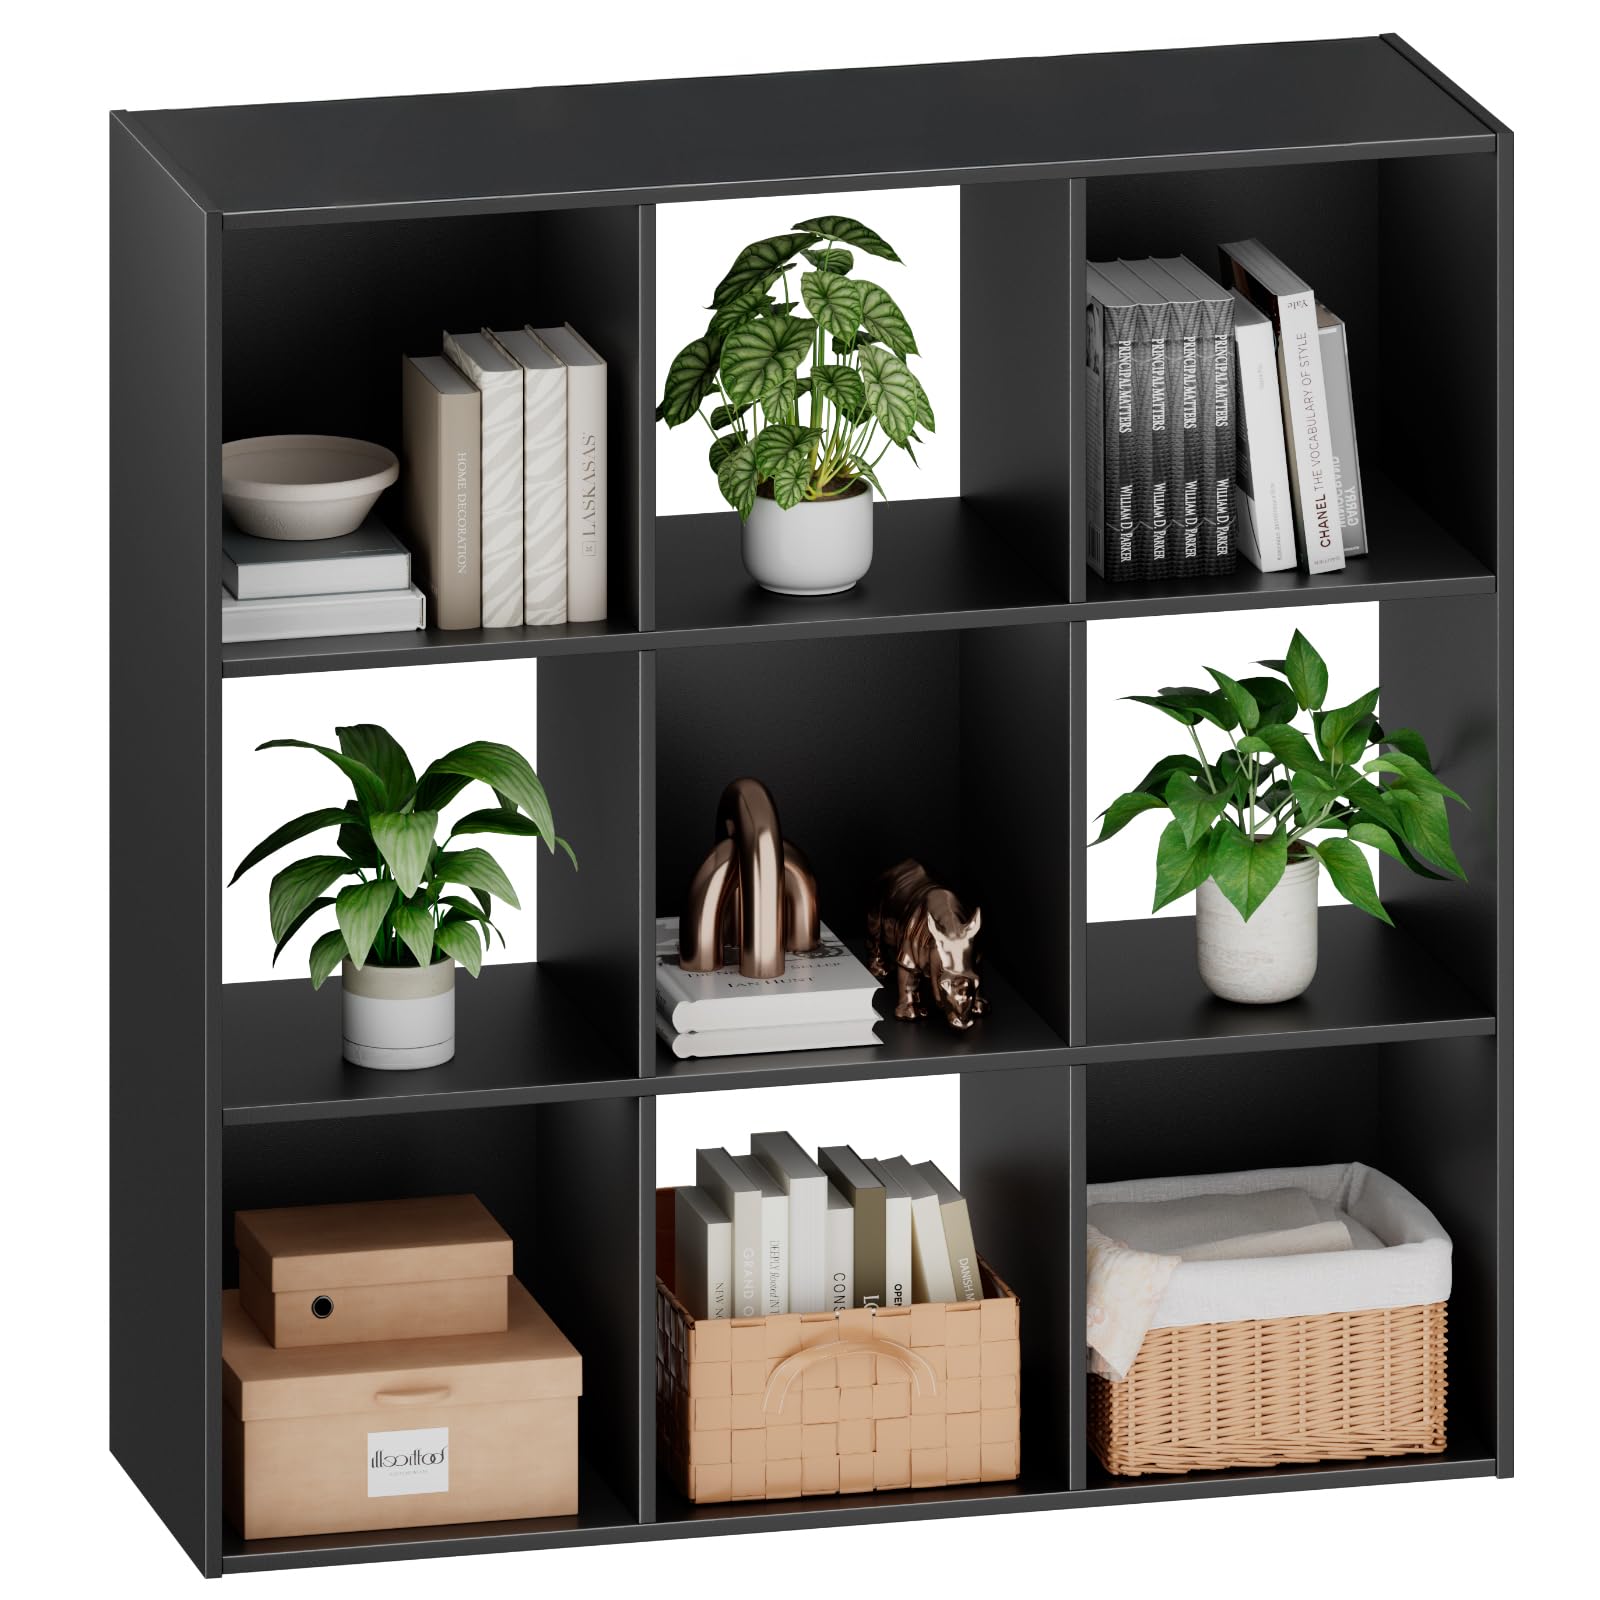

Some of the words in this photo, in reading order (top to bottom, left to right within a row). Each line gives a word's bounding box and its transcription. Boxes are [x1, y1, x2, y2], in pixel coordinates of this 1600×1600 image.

[1287, 299, 1308, 310] Yale
[1118, 340, 1132, 390] PRINCIPAL
[1151, 338, 1165, 387] PRINCIPAL
[1183, 336, 1196, 386] PRINCIPAL
[1215, 334, 1228, 383] PRINCIPAL
[1296, 332, 1310, 368] STYLE
[1301, 371, 1312, 385] OF
[1119, 390, 1132, 433] MATTERS
[1152, 387, 1165, 431] MATTERS
[1183, 386, 1197, 429] MATTERS
[1215, 383, 1229, 427] MATTERS
[1303, 390, 1321, 467] VOCABULARY
[457, 450, 467, 489] HOME
[582, 431, 596, 536] LASKASAS
[1311, 469, 1324, 492] THE
[1120, 484, 1133, 521] WILLIAM
[1153, 482, 1167, 519] WILLIAM
[1184, 480, 1198, 516] WILLIAM
[1216, 478, 1230, 515] WILLIAM
[456, 493, 467, 575] DECORATION
[1120, 521, 1133, 532] D.
[1153, 519, 1166, 529] D.
[1184, 517, 1198, 527] D.
[1216, 515, 1230, 525] D.
[1315, 494, 1331, 548] CHANEL
[1120, 532, 1132, 562] PARKER
[1153, 530, 1166, 560] PARKER
[1185, 528, 1197, 558] PARKER
[1216, 525, 1229, 556] PARKER
[743, 1247, 754, 1300] GRAND
[769, 1240, 781, 1270] DEEPLY
[959, 1256, 974, 1292] DANISH
[715, 1282, 725, 1304] NEW
